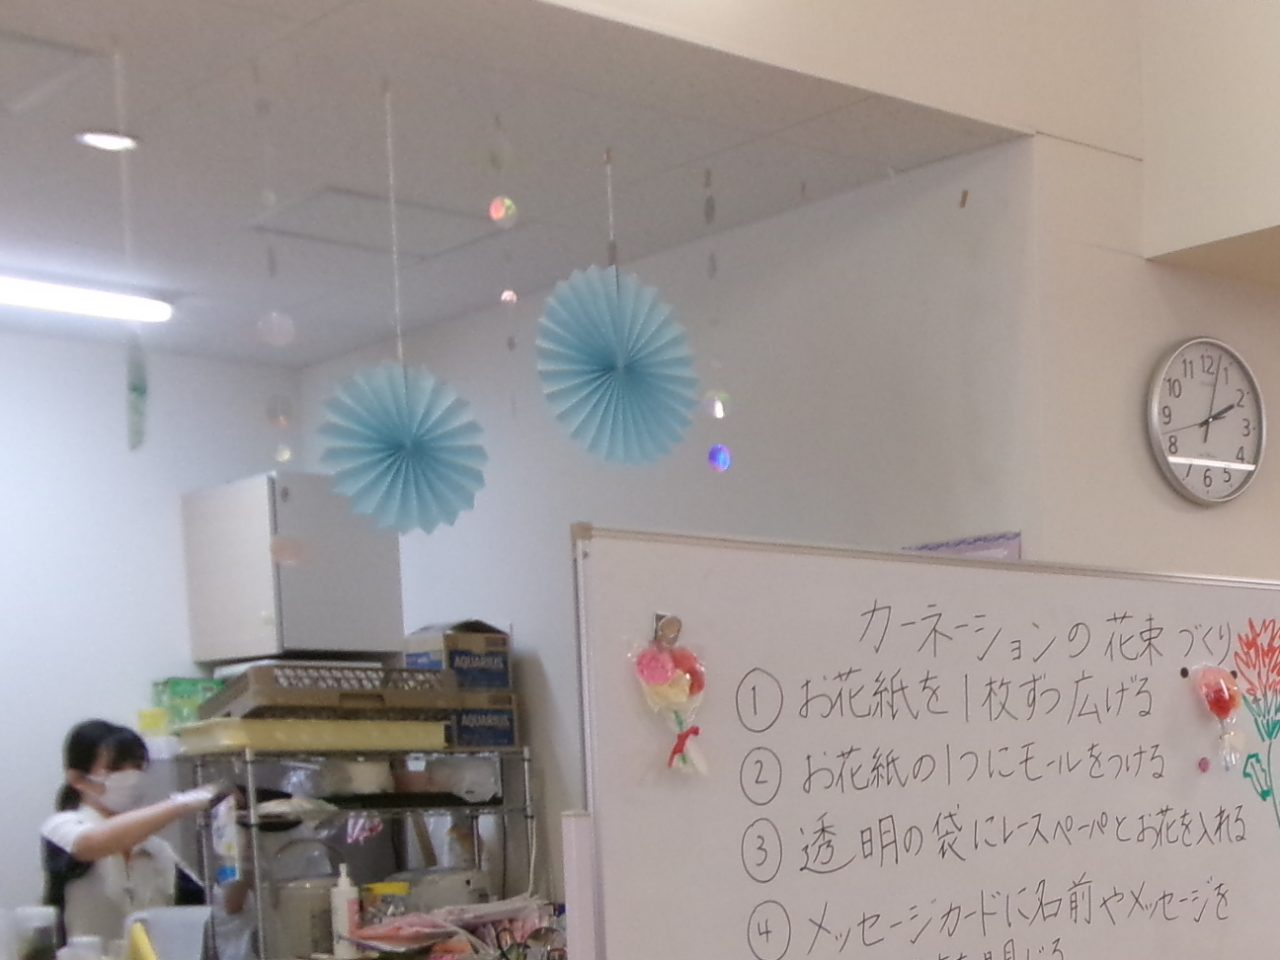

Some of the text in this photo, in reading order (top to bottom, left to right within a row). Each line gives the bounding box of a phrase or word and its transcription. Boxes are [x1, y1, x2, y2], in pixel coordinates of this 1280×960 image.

[1182, 358, 1194, 380] 11
[1200, 354, 1215, 376] 12
[1223, 366, 1229, 385] 1
[1166, 378, 1182, 398] 10
[1236, 388, 1245, 408] 2
[1162, 405, 1172, 425] 9
[1242, 418, 1251, 437] 3
[1168, 435, 1178, 454] 8
[1235, 446, 1245, 463] 4
[1203, 468, 1212, 488] 6
[1223, 464, 1232, 483] 5
